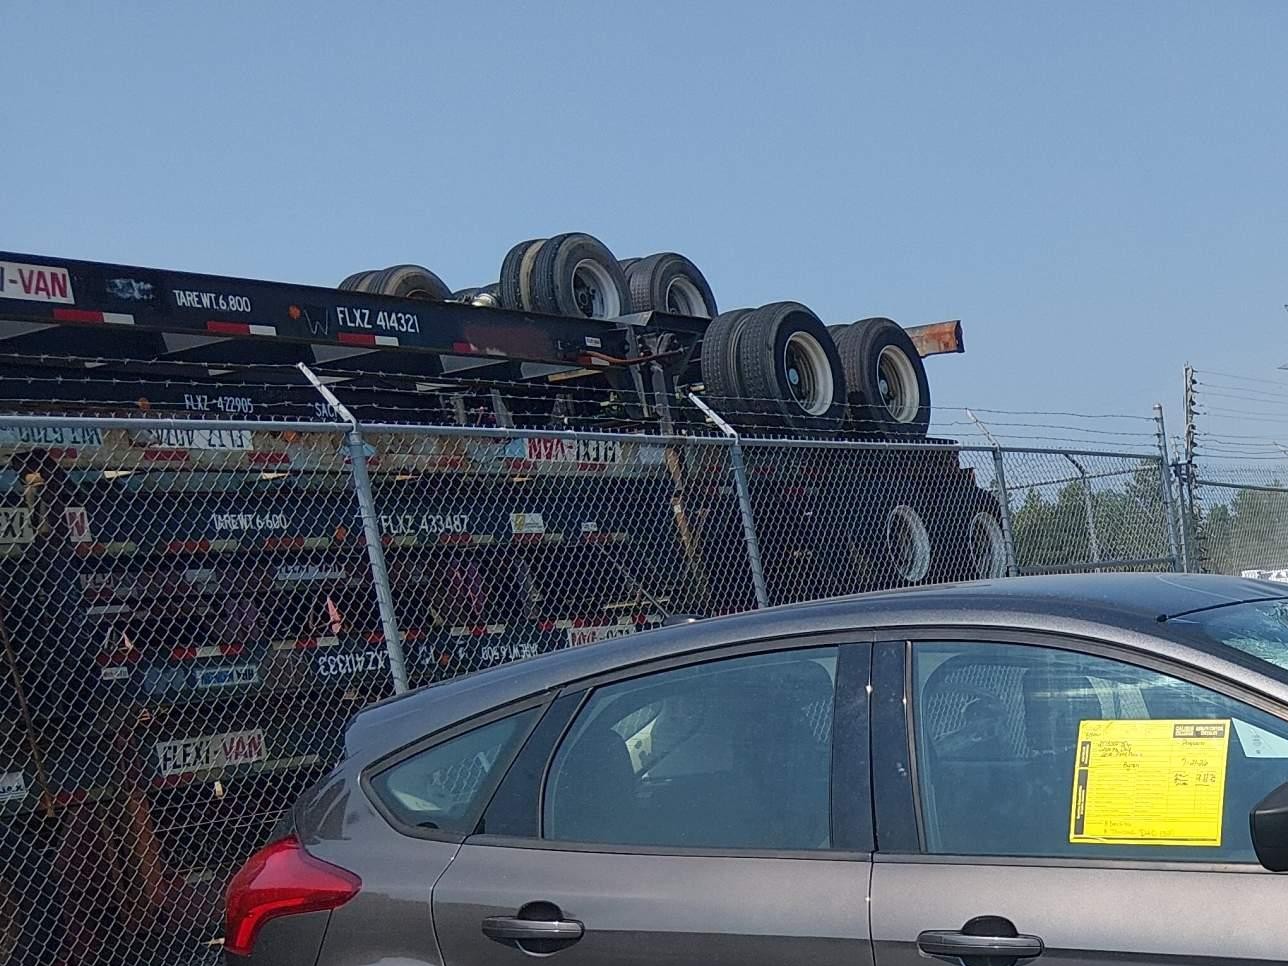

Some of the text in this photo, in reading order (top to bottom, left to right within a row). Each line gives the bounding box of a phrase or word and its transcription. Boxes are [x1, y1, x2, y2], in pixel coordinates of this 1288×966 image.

[172, 289, 202, 308] TARE
[336, 306, 420, 333] FLXZ 414321
[184, 393, 254, 414] FLXZ 422905
[380, 515, 416, 534] FLXZ
